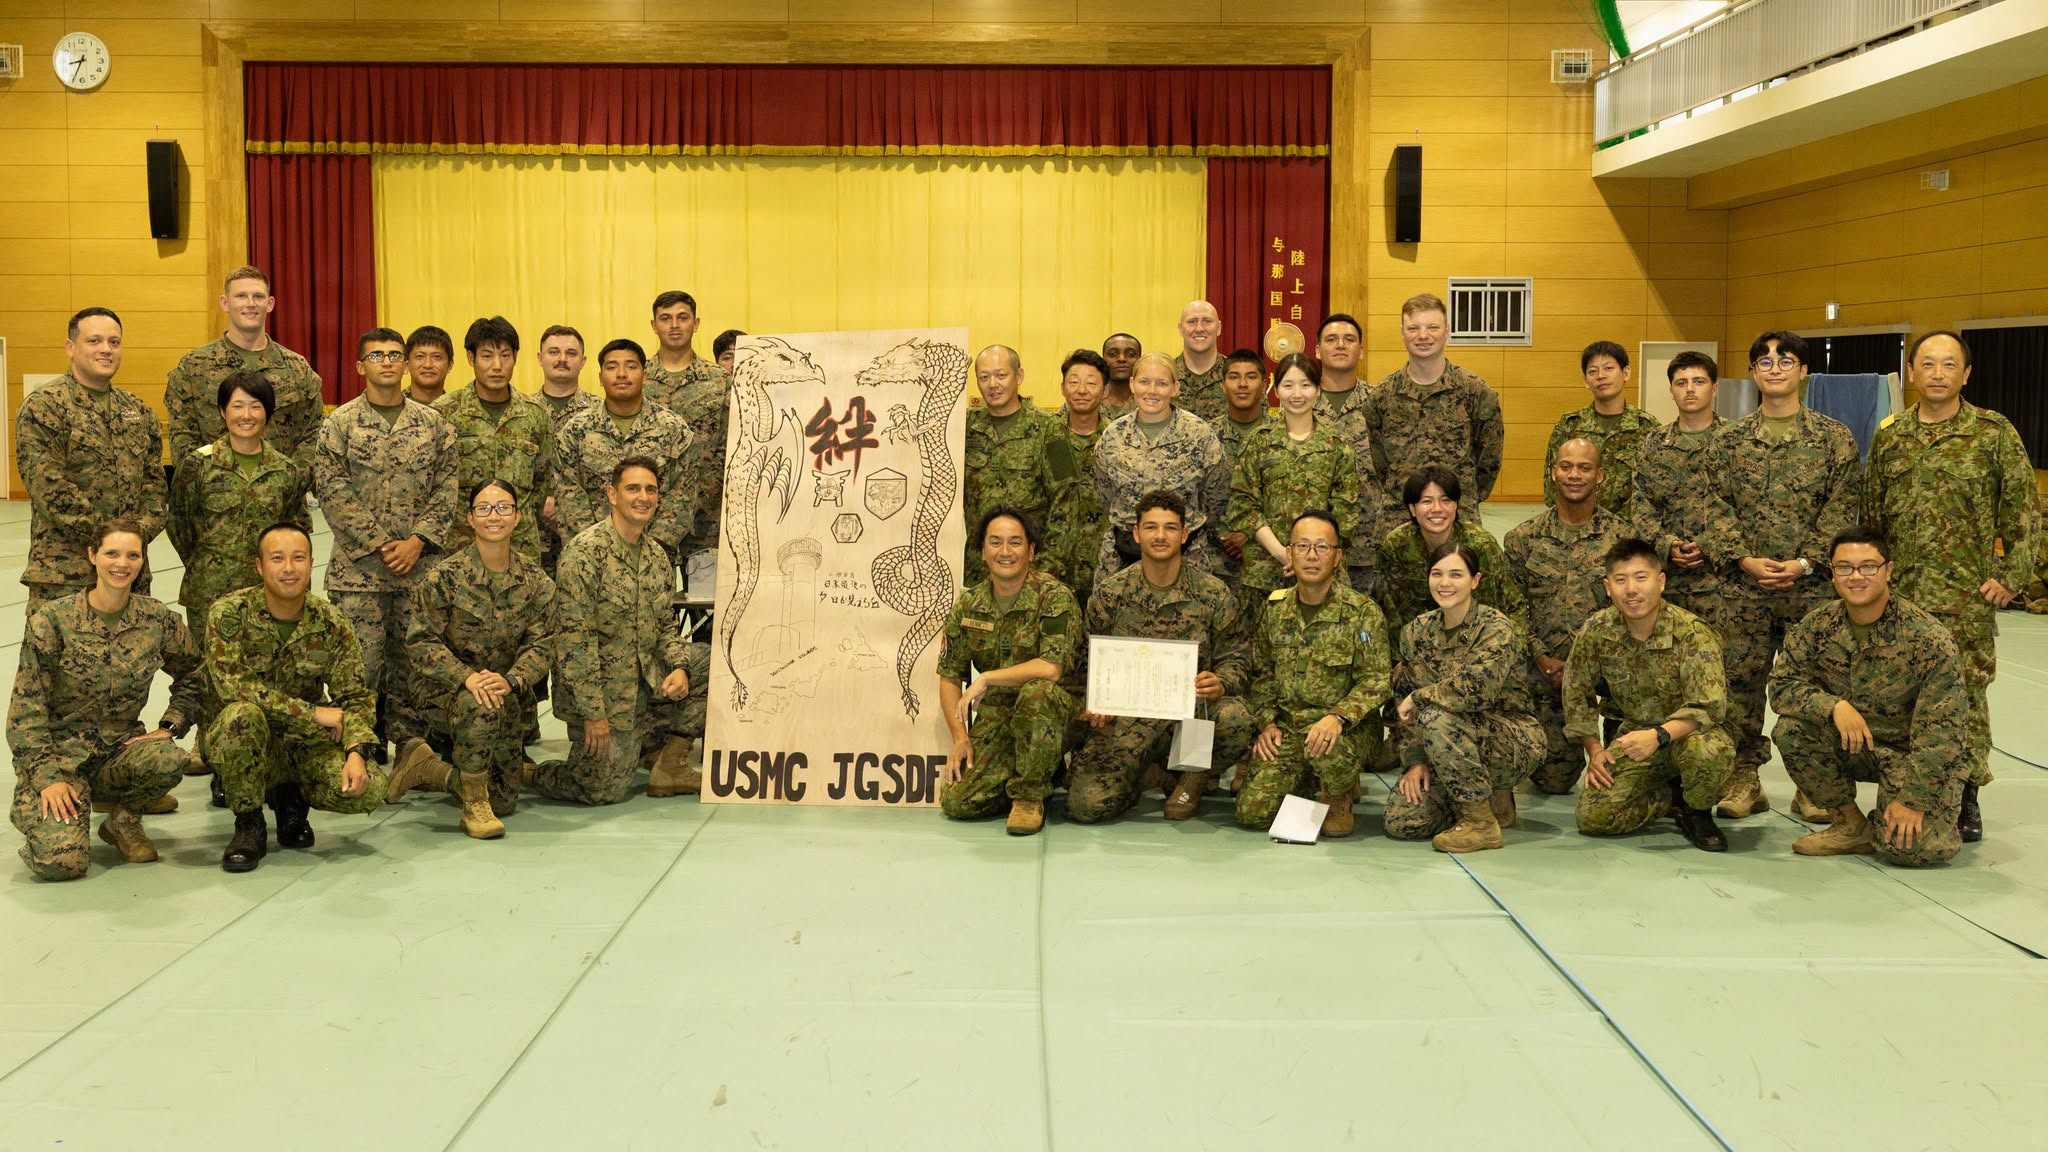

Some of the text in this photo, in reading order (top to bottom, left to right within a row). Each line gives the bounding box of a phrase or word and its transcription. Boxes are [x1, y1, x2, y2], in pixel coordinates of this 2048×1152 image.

[1290, 250, 1305, 320] 陸上自
[804, 395, 880, 487] 絆
[711, 750, 948, 804] USMC JGSDF
